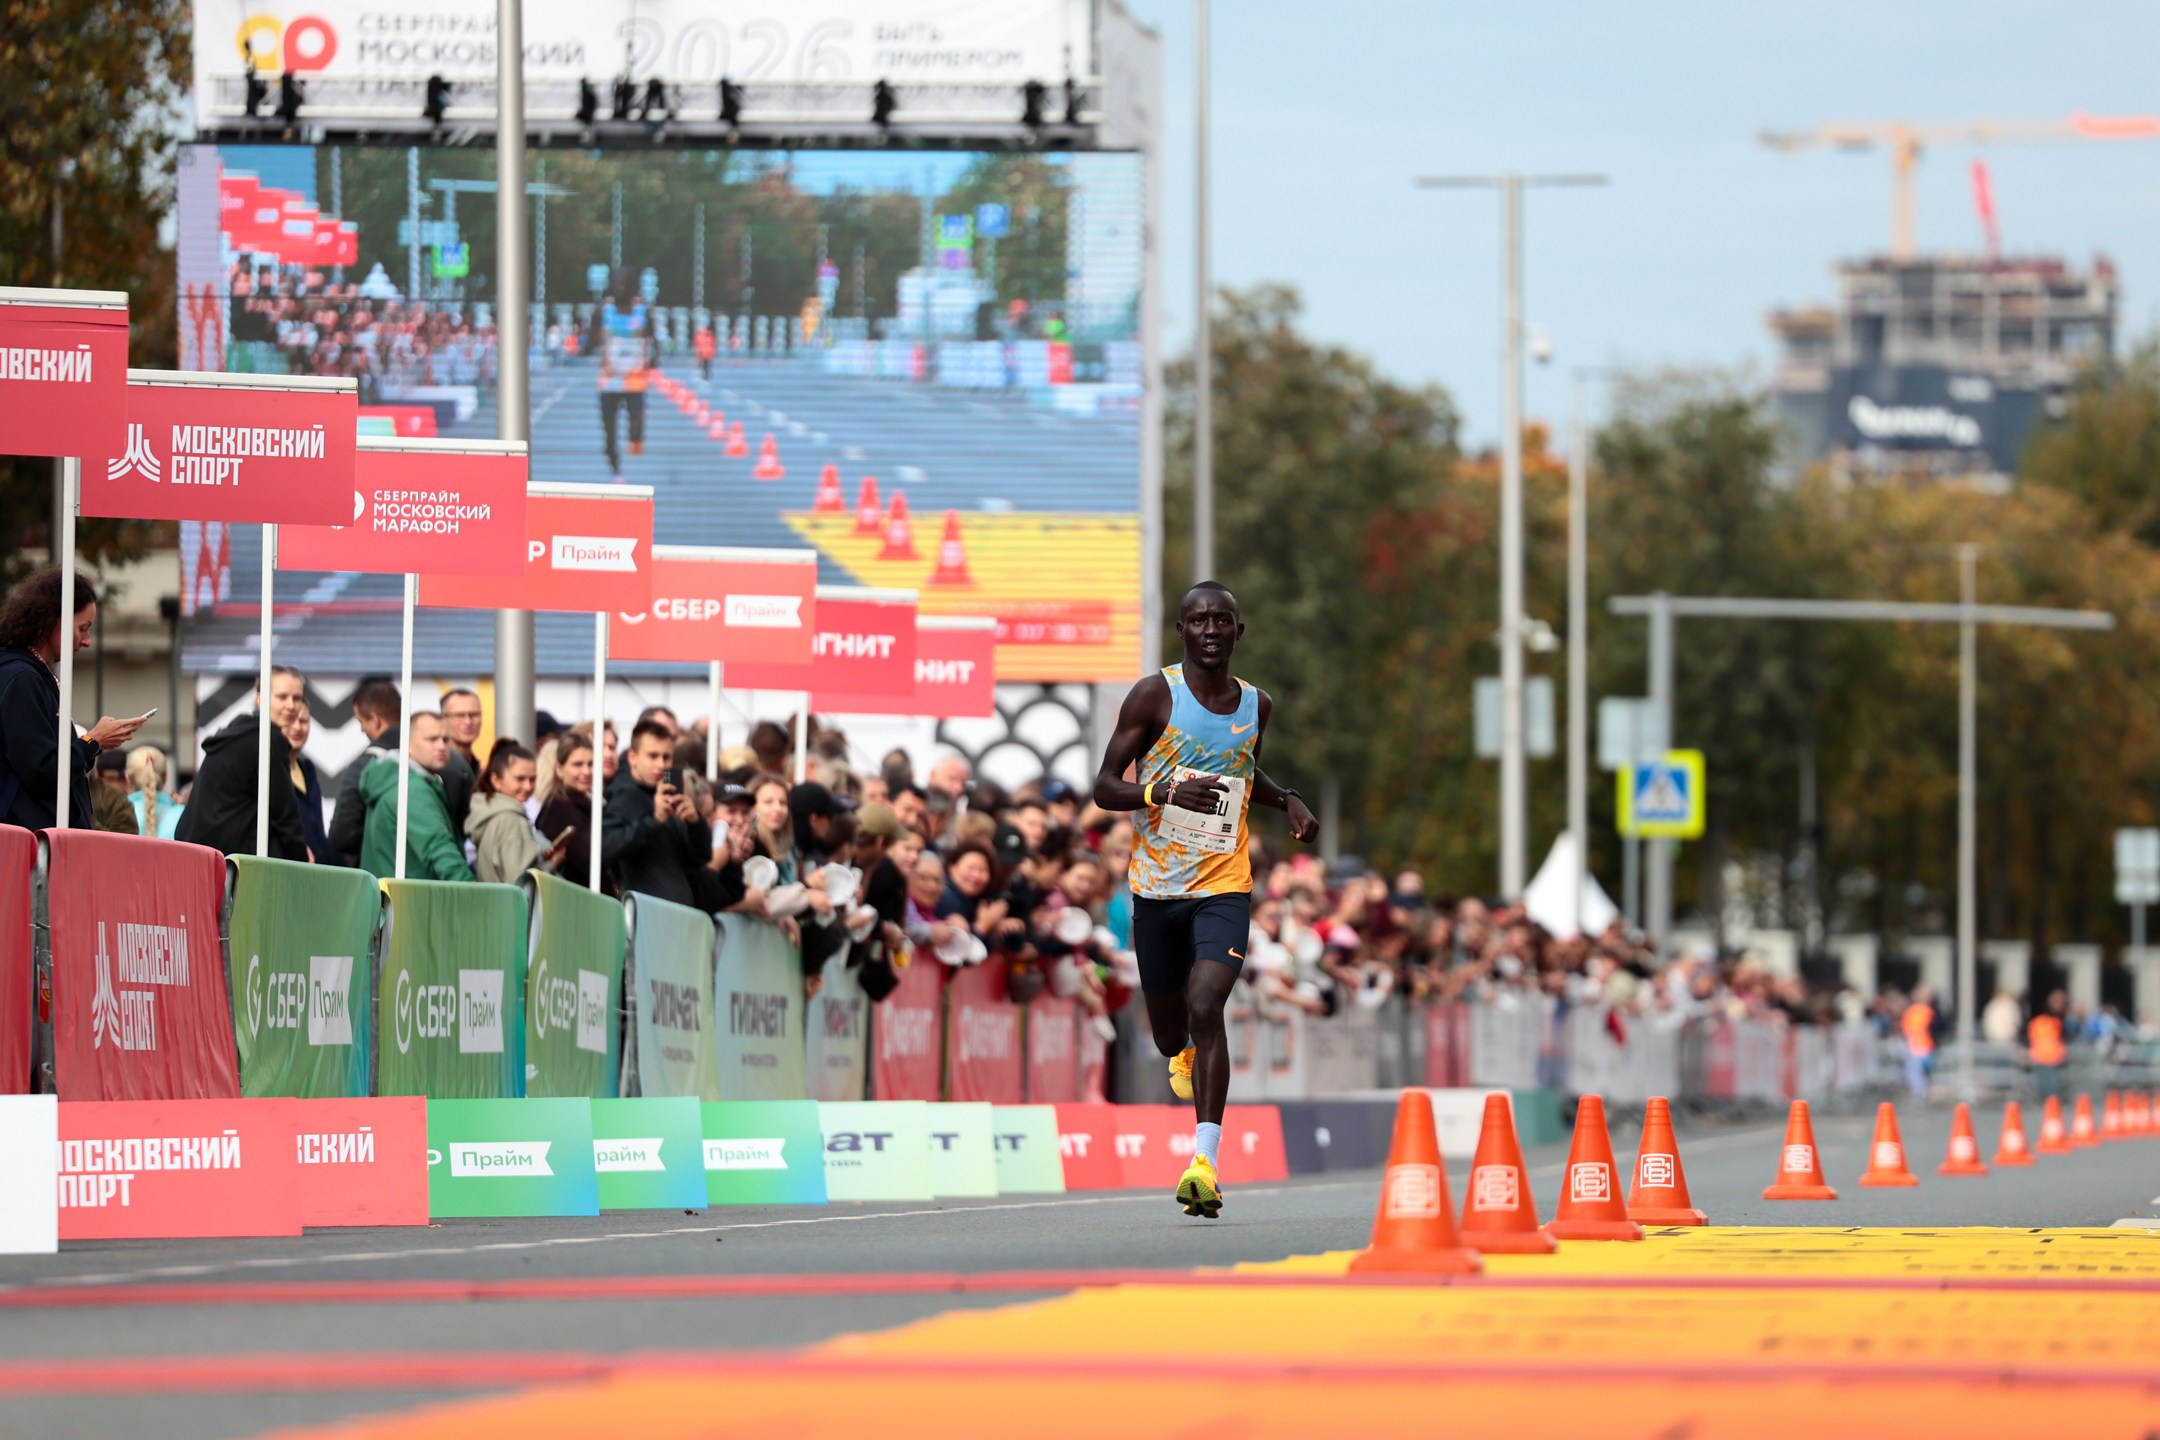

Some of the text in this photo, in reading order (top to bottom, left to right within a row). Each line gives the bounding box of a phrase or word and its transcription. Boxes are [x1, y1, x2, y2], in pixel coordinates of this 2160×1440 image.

[357, 13, 497, 33] СБЕРПРАЙ
[357, 36, 586, 65] МОСКОВКИЙ
[171, 424, 325, 459] МОСКОВСКИЙ
[171, 455, 243, 486] СПОРТ
[373, 490, 460, 504] СБЕРПРАЙМ
[373, 503, 491, 520] МОСКОВСКИЙ
[373, 518, 460, 534] МАРАФОН
[561, 544, 621, 562] Прайм
[653, 598, 788, 621] СБЕР Прайм
[266, 972, 307, 1030] СБЕР
[416, 985, 496, 1038] СБЕР Прайм
[550, 976, 578, 1031] СБЕР
[461, 1150, 533, 1170] Прайм
[708, 1147, 770, 1165] Прайм
